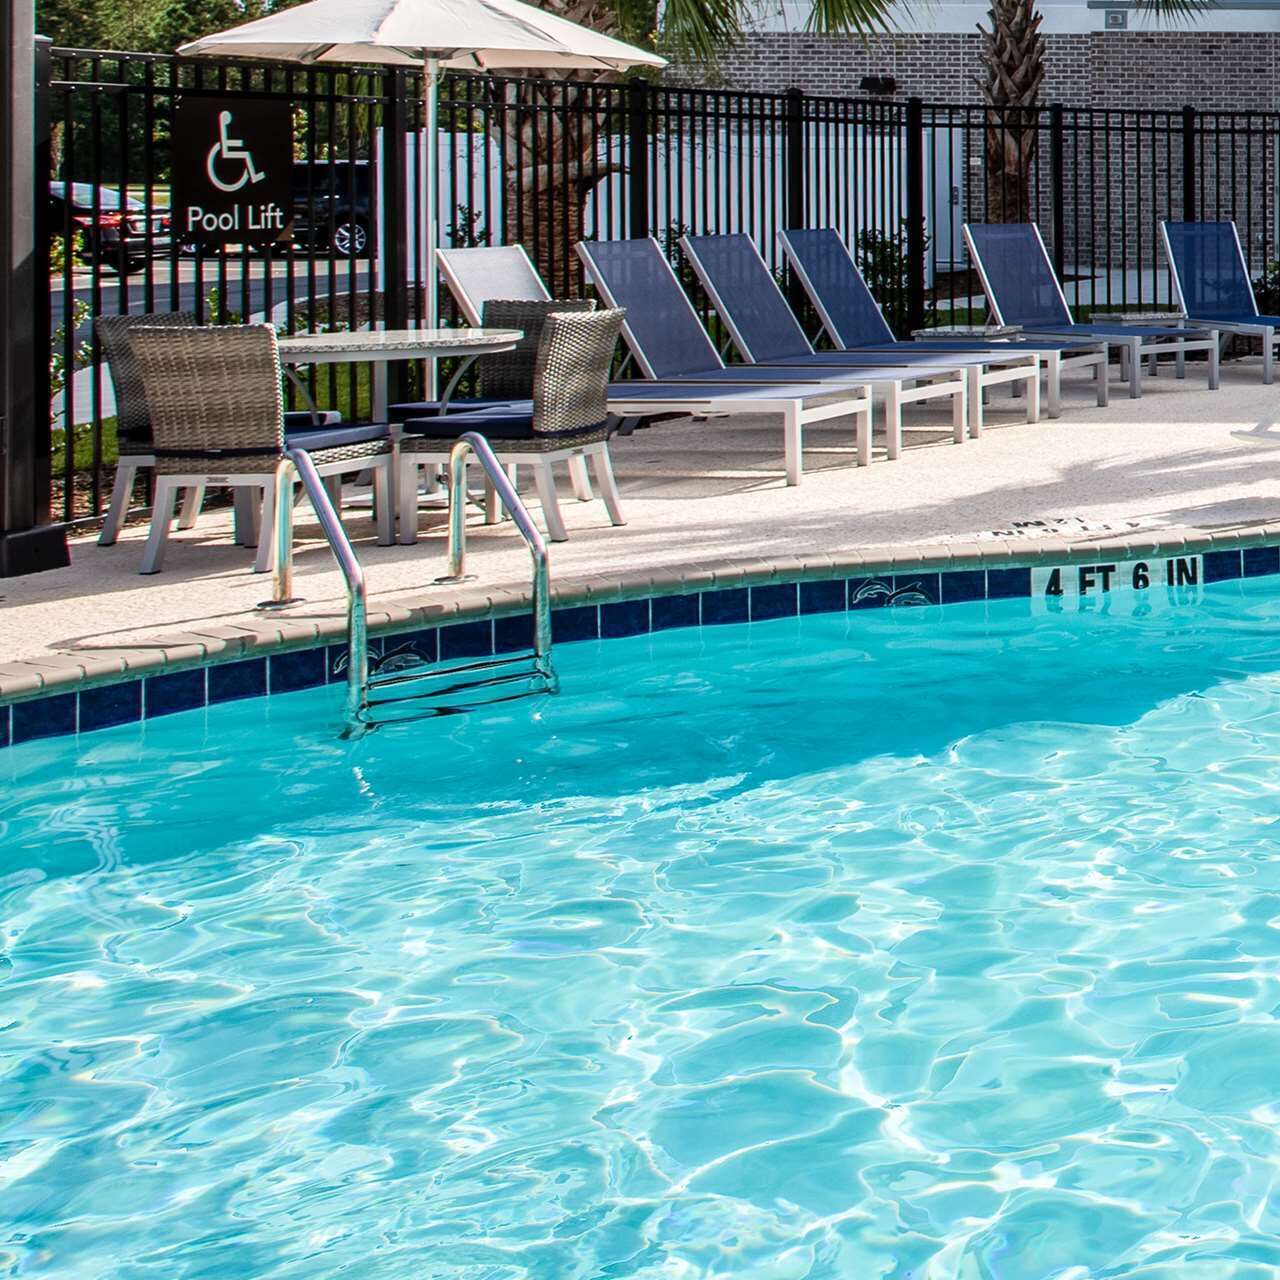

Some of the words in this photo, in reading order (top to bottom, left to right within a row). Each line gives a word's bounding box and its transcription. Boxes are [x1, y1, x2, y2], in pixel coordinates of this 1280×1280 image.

[187, 204, 239, 231] Pool
[248, 203, 284, 230] Lift
[1045, 568, 1064, 596] 4
[1078, 564, 1116, 595] FT
[1132, 562, 1150, 590] 6
[1166, 557, 1198, 587] IN
